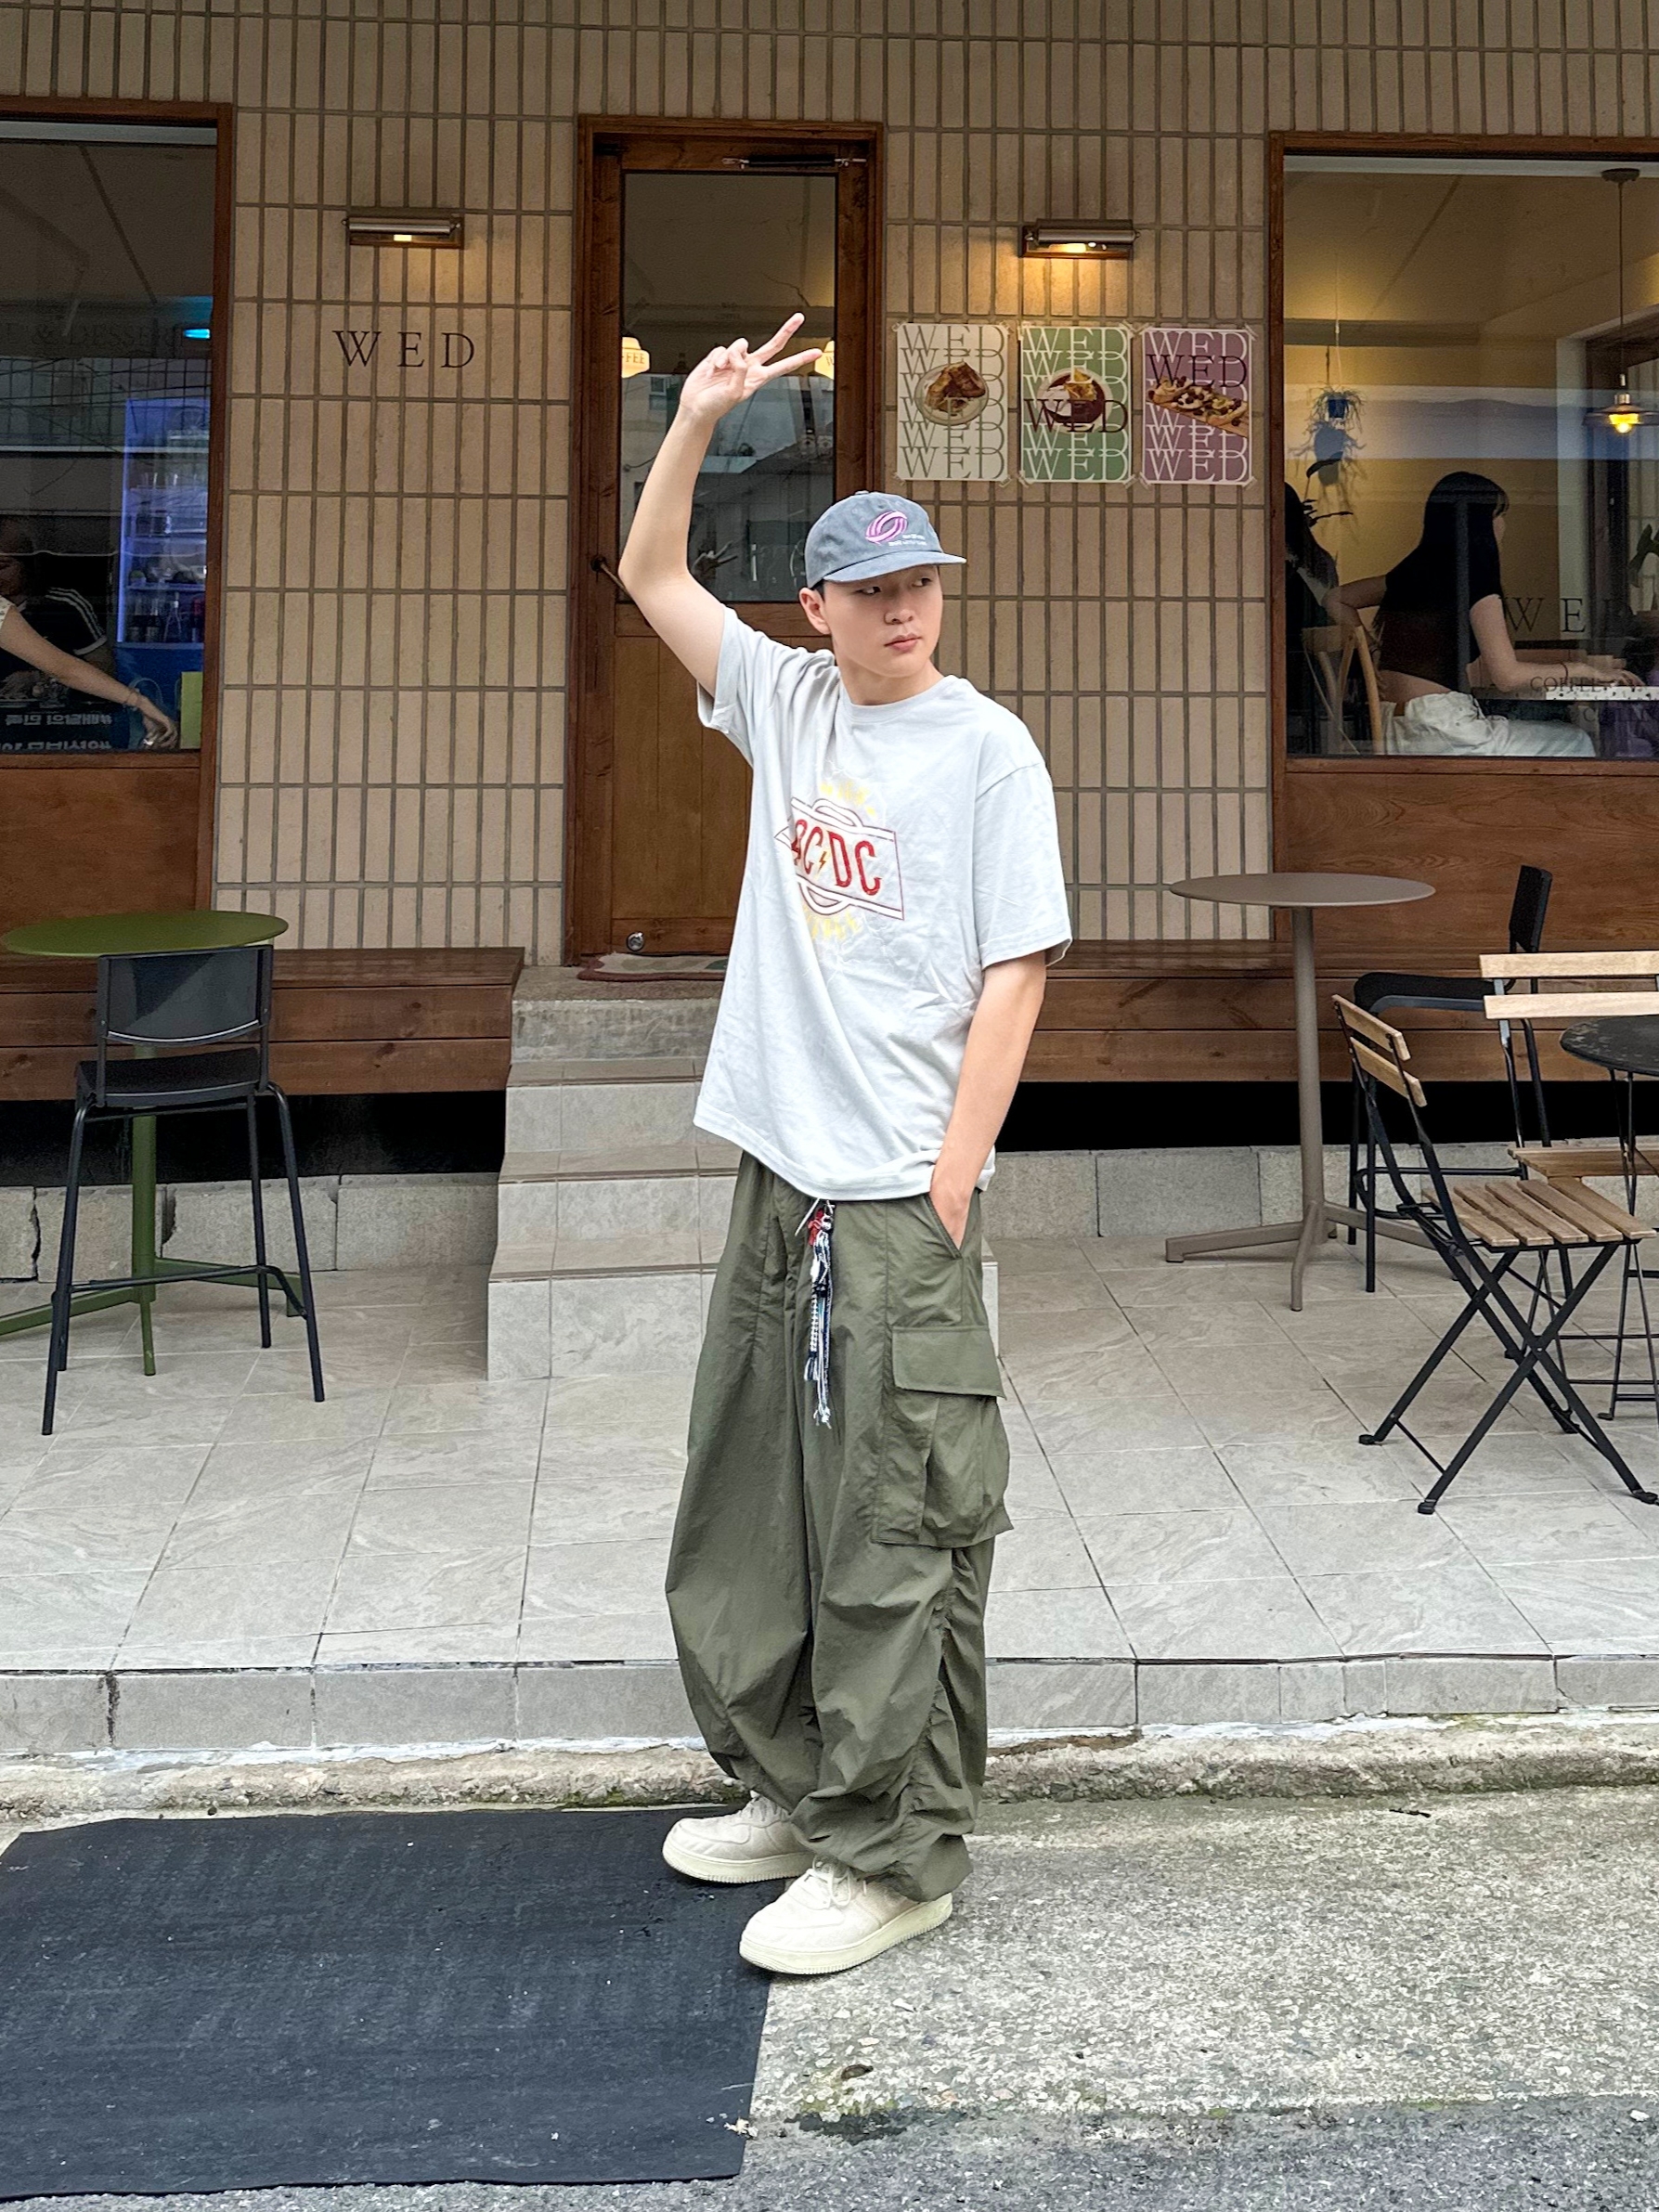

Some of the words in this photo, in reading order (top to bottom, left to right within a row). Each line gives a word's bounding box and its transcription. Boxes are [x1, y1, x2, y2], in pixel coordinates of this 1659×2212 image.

[332, 330, 474, 368] WED
[901, 325, 1004, 357] WED
[1022, 327, 1128, 360] WED
[1147, 330, 1248, 364] WED
[1147, 354, 1248, 388] WED
[1023, 398, 1128, 433] WED
[900, 446, 1004, 479] WED
[1023, 447, 1128, 481] WED
[1147, 449, 1248, 483] WED
